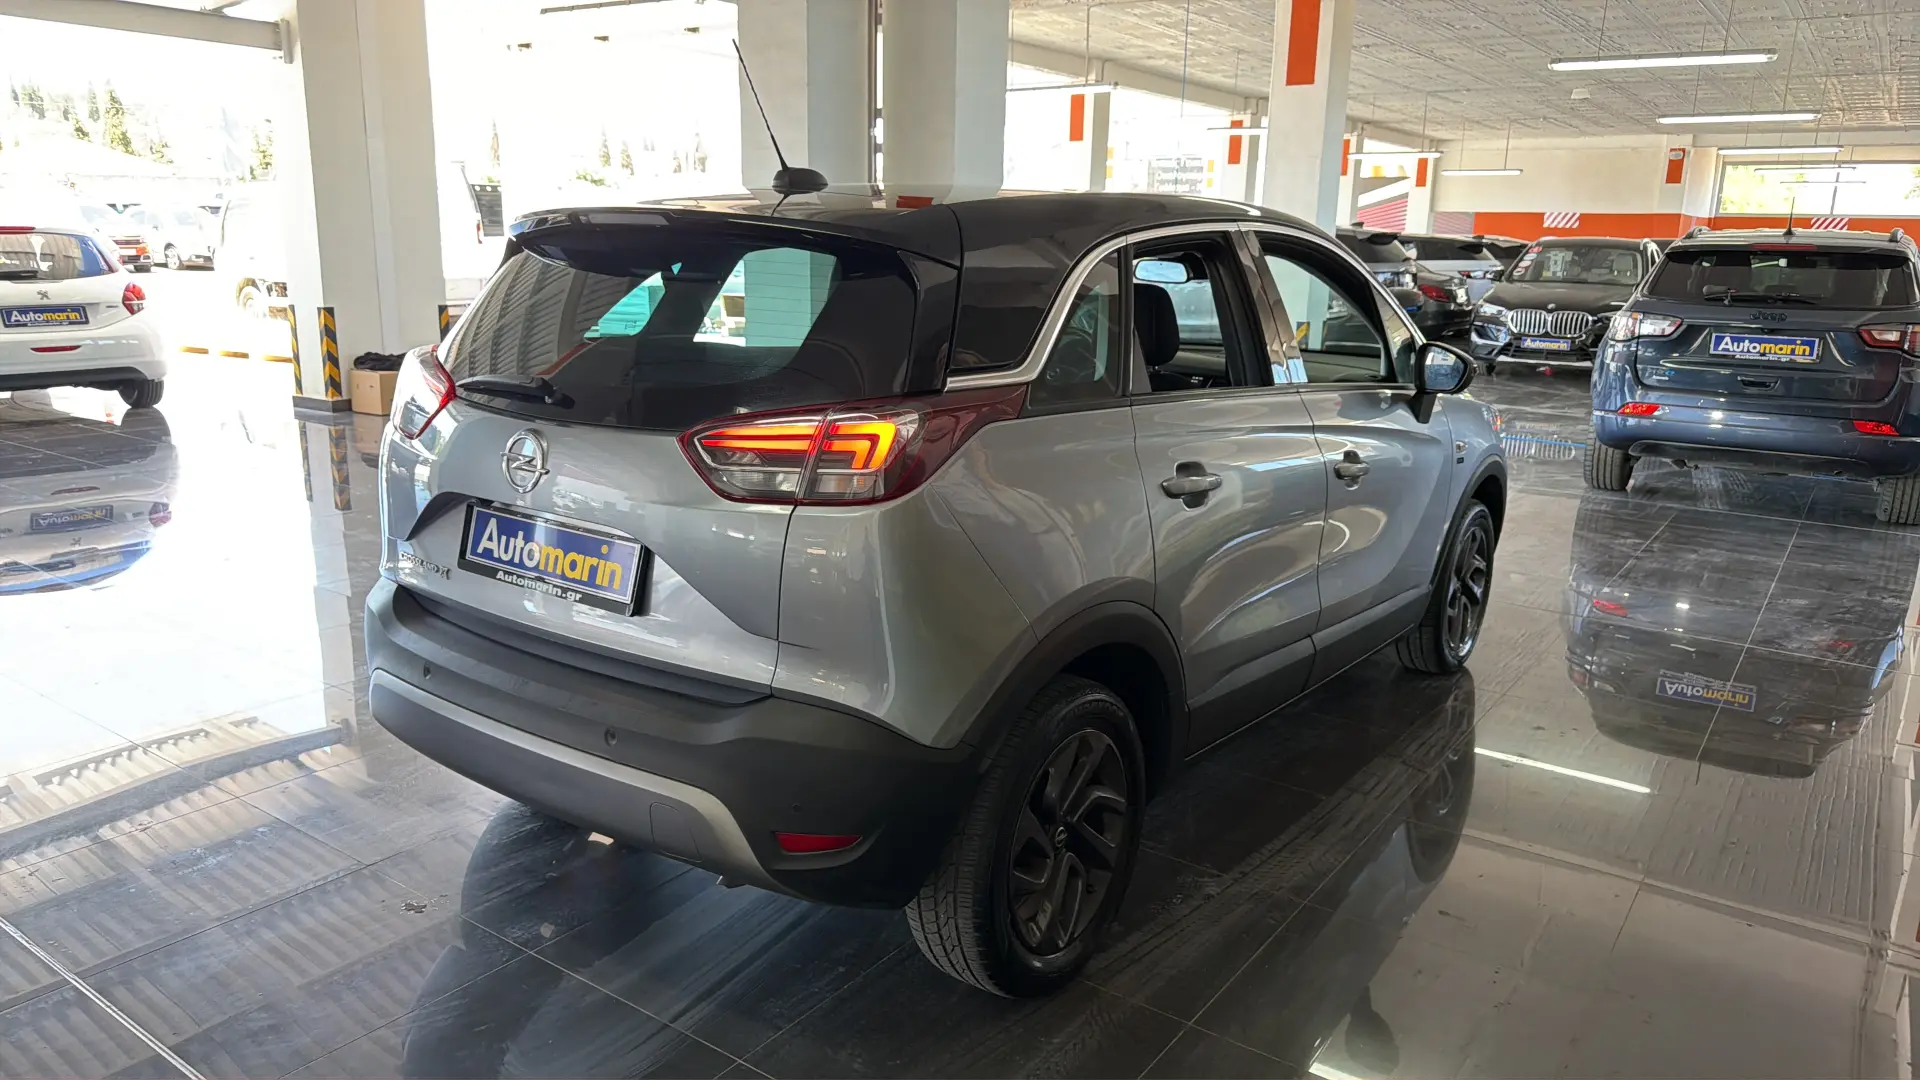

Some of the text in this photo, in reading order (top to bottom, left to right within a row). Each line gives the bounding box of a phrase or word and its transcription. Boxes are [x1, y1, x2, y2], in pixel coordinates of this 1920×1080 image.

[11, 309, 81, 322] Automarin
[1749, 310, 1788, 323] Jeep
[1524, 337, 1567, 349] Automarin
[1718, 336, 1810, 356] Automarin
[476, 517, 622, 590] Automarin
[495, 569, 583, 602] Automarin.gr
